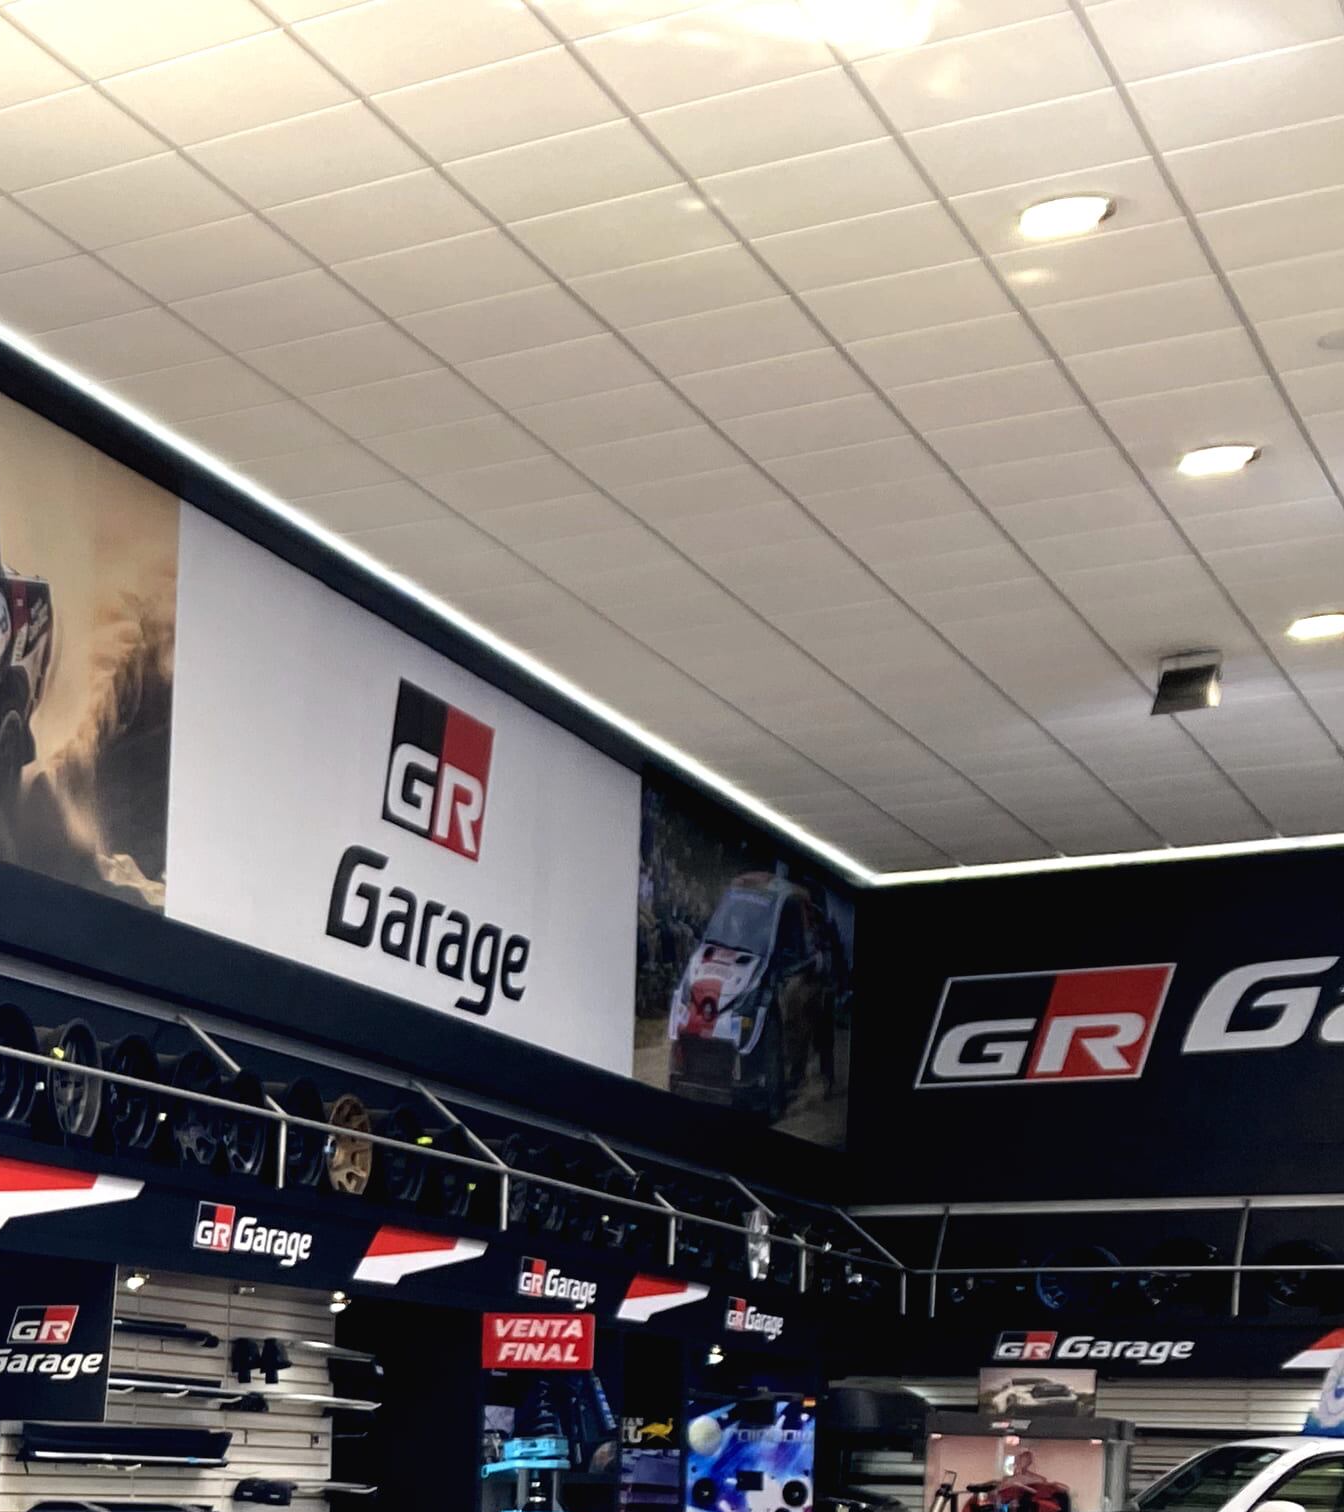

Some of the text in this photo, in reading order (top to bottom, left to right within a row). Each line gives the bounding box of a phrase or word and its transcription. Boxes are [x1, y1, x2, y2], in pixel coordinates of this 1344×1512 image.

[387, 742, 485, 853] GR
[326, 845, 530, 1016] Garage
[932, 956, 1344, 1078] GR G
[197, 1216, 313, 1267] GR Garage
[544, 1268, 597, 1309] Garage
[12, 1320, 71, 1340] GR
[495, 1318, 584, 1338] VENTA
[745, 1306, 784, 1341] Garage
[497, 1342, 579, 1363] FINAL
[1057, 1335, 1196, 1365] Garage
